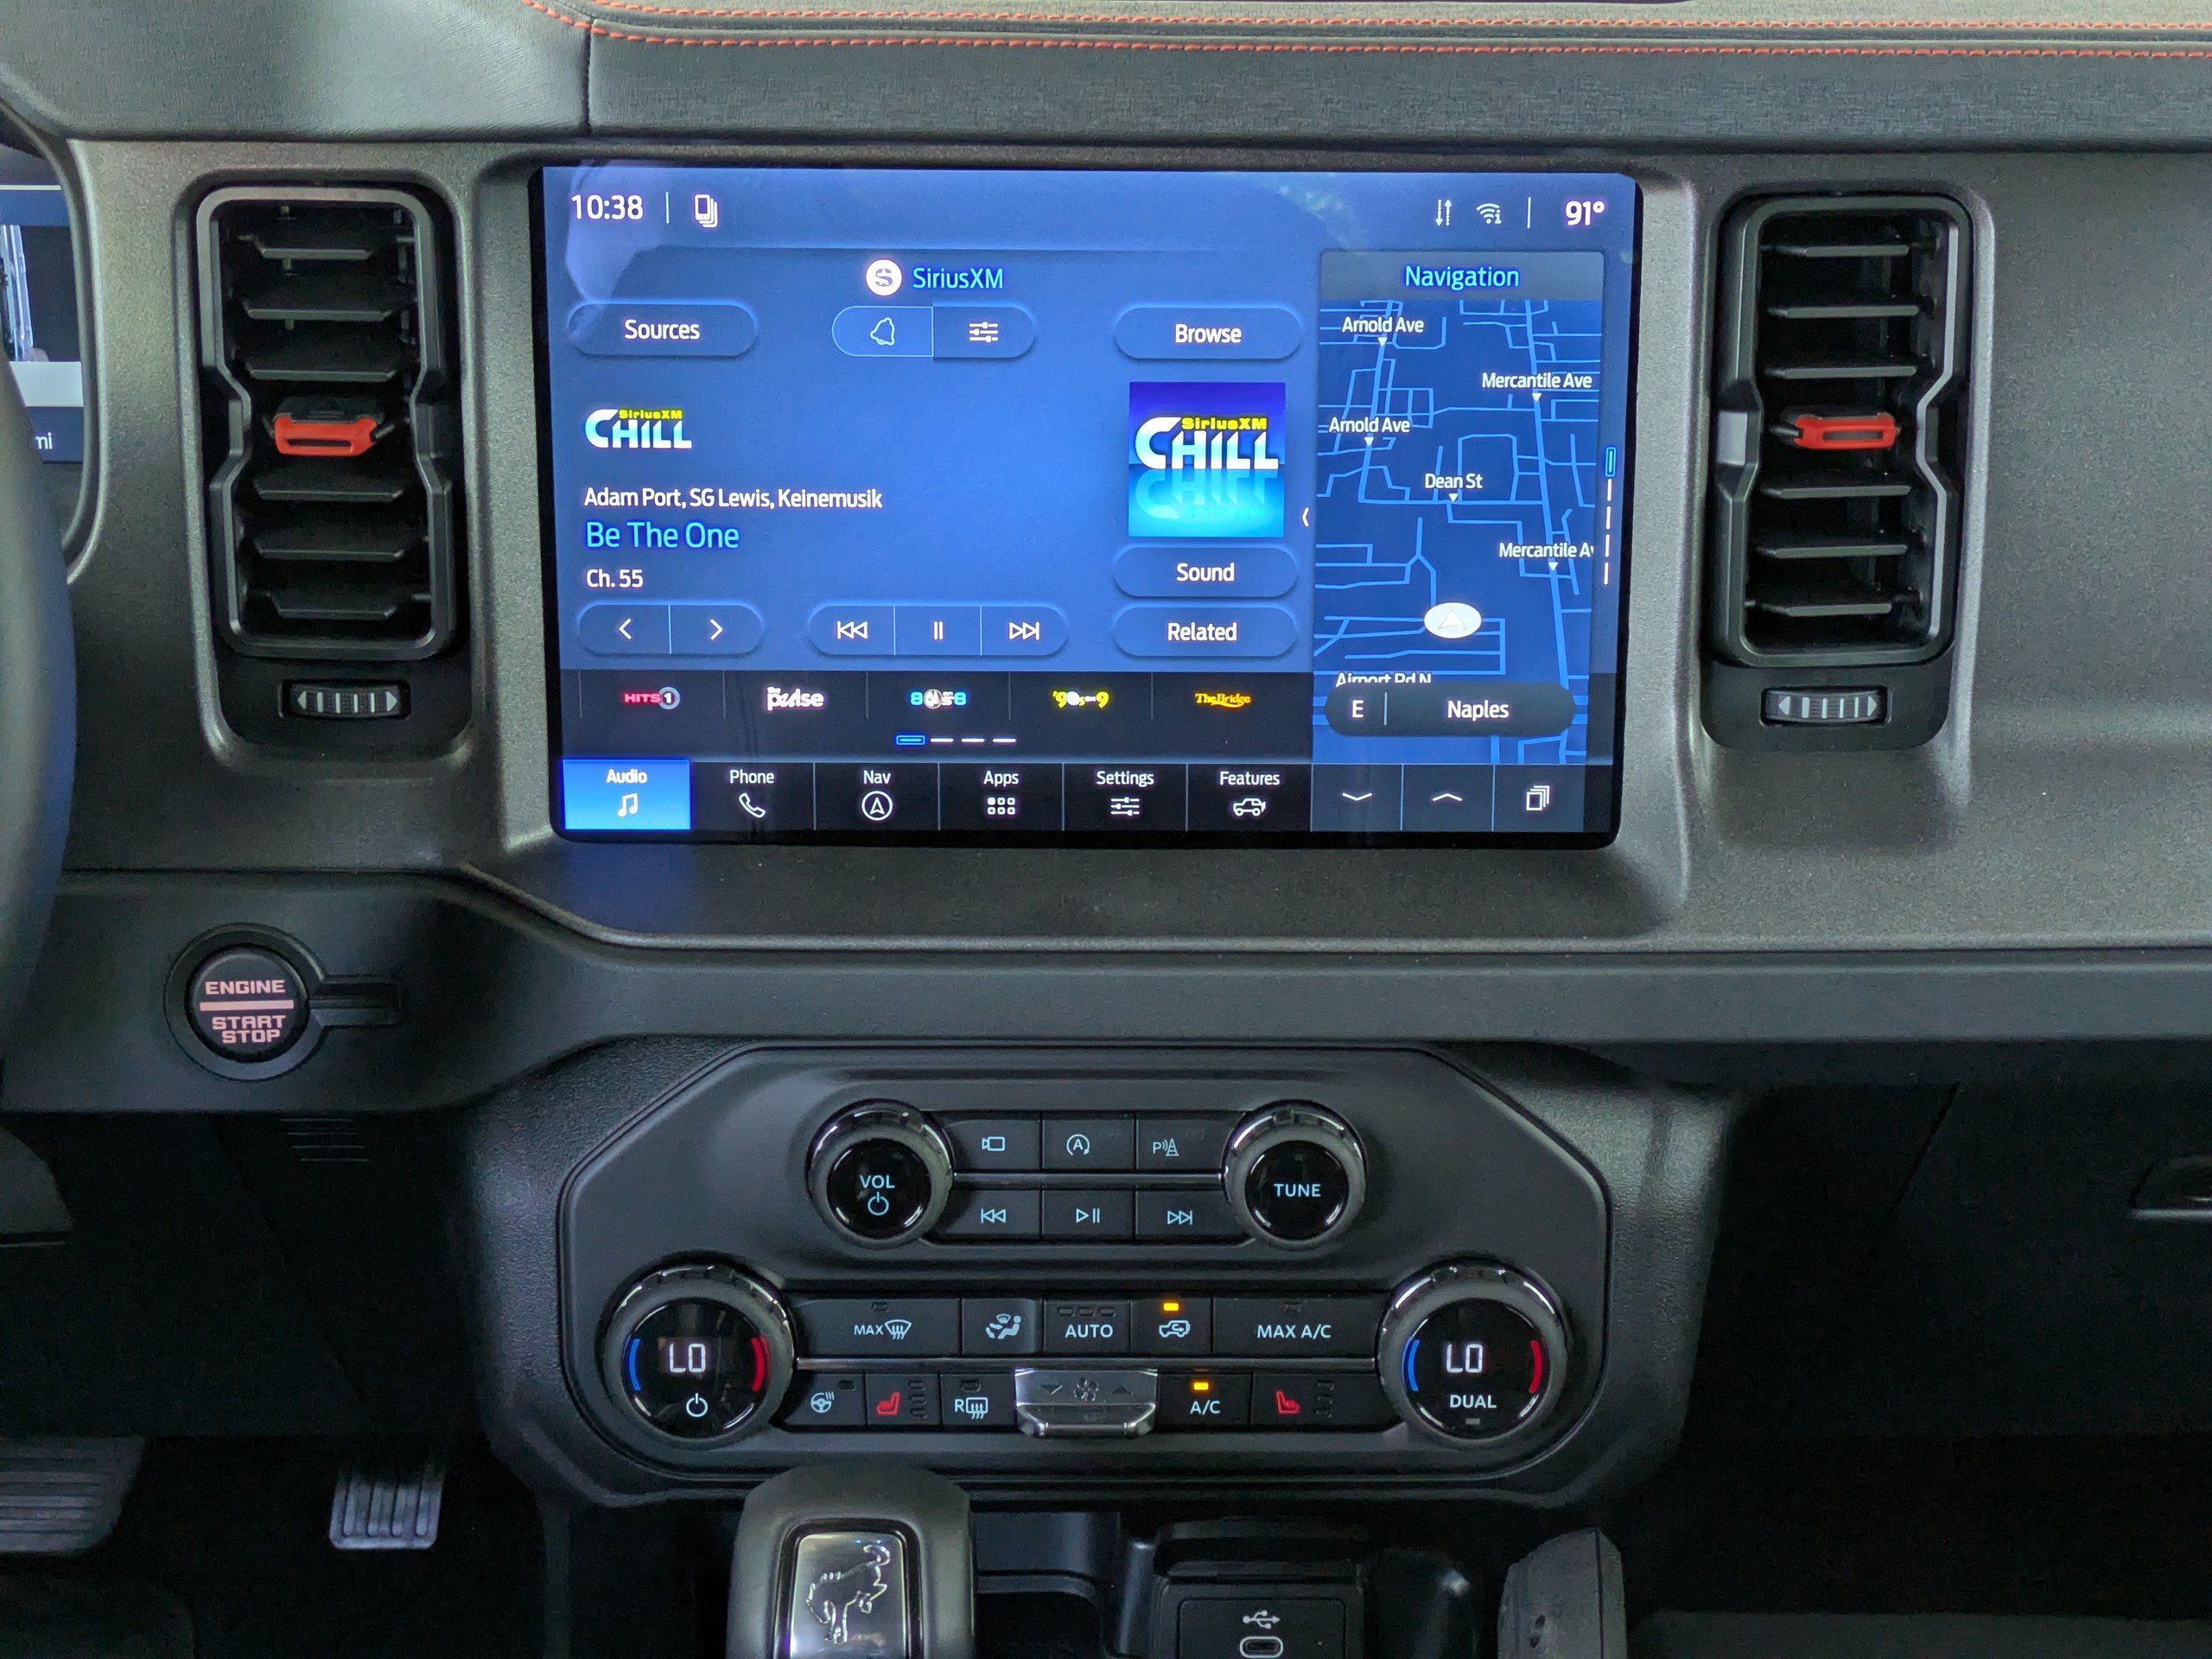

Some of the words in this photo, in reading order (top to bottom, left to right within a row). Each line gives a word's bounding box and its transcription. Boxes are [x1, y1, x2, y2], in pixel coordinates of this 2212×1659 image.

[571, 194, 644, 220] 10:38
[912, 267, 1004, 289] SiriusXM
[1404, 265, 1520, 291] Navigation
[624, 319, 701, 340] Sources
[1341, 316, 1393, 334] Arnold
[1395, 317, 1425, 334] Ave
[1174, 323, 1243, 344] Browse
[1481, 372, 1561, 389] Mercantile
[1563, 373, 1592, 389] Ave
[619, 409, 683, 420] SiriusXM
[584, 409, 692, 448] CHILL
[1180, 416, 1268, 430] SiriusXM
[1328, 416, 1379, 433] Arnold
[1381, 417, 1410, 433] Ave
[1135, 416, 1279, 470] CHILL
[1424, 474, 1464, 489] Dean
[1465, 474, 1484, 489] St
[584, 487, 639, 507] Adam
[642, 487, 687, 510] Port,
[690, 488, 715, 507] SG
[718, 489, 775, 510] Lewis,
[778, 489, 883, 508] Keinemusik
[586, 521, 620, 549] Be
[626, 522, 678, 549] The
[685, 524, 740, 549] One
[1498, 542, 1577, 558] Mercantile
[586, 569, 616, 588] Ch.
[619, 569, 644, 588] 55
[1176, 562, 1235, 582] Sound
[1167, 621, 1237, 642] Related
[624, 693, 661, 703] HITS
[1351, 699, 1364, 719] E
[1446, 699, 1510, 721] Naples
[606, 769, 648, 785] Audio
[729, 769, 775, 785] Phone
[862, 770, 892, 785] Nav
[983, 770, 1020, 788] Apps
[1096, 770, 1154, 789] Settings
[1219, 771, 1281, 786] Features
[205, 979, 286, 995] ENGINE
[212, 1014, 287, 1030] START
[221, 1029, 281, 1044] STOP
[860, 1174, 895, 1189] VOL
[1274, 1183, 1322, 1197] TUNE
[854, 1323, 884, 1336] MAX
[1065, 1324, 1114, 1338] AUTO
[1256, 1324, 1296, 1338] MAX
[1300, 1324, 1332, 1339] A/C
[668, 1343, 708, 1373] LO
[1446, 1343, 1484, 1374] LO
[954, 1397, 965, 1413] R
[1189, 1400, 1221, 1414] A/C
[1449, 1394, 1497, 1409] DUAL
